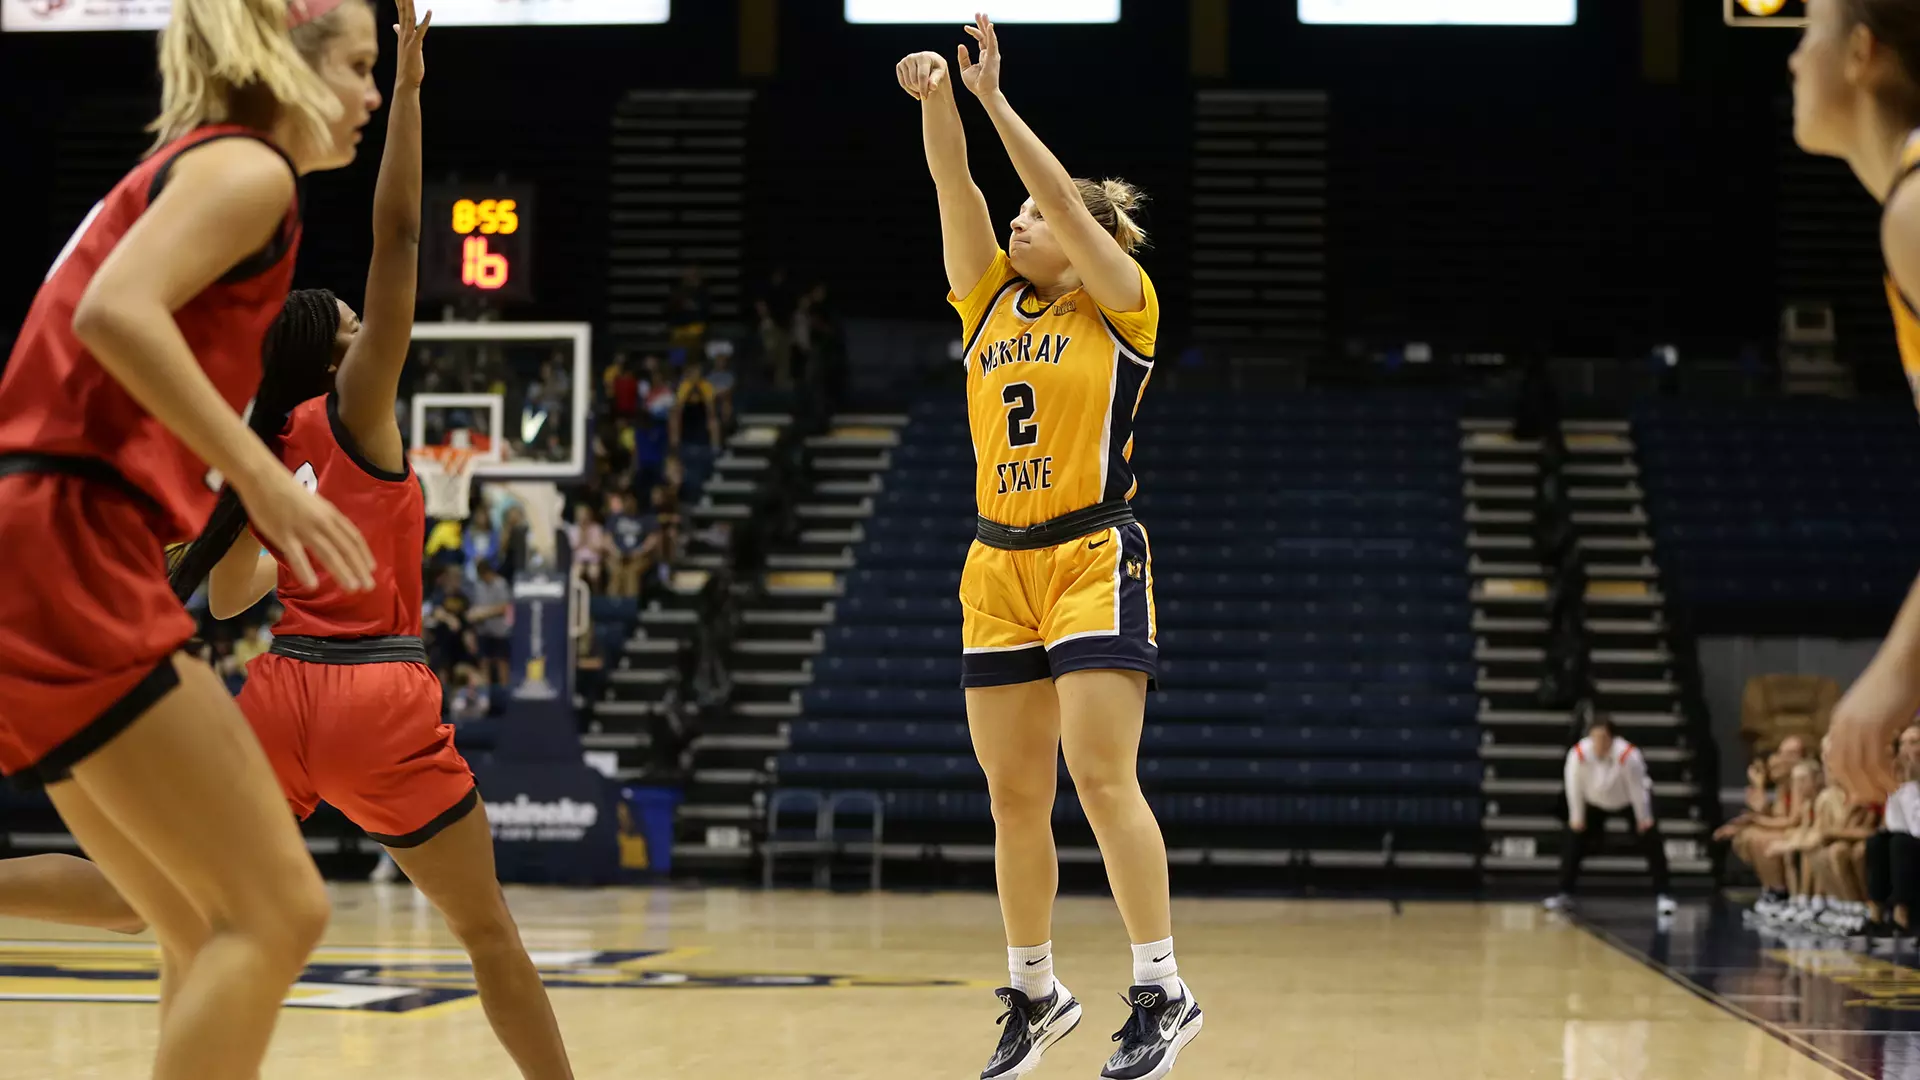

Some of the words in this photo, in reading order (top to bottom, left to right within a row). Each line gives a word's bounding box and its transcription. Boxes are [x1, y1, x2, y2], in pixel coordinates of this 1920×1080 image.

[452, 199, 519, 235] 8:55
[462, 235, 509, 290] 16
[1000, 380, 1039, 450] 2
[996, 456, 1053, 495] STATE
